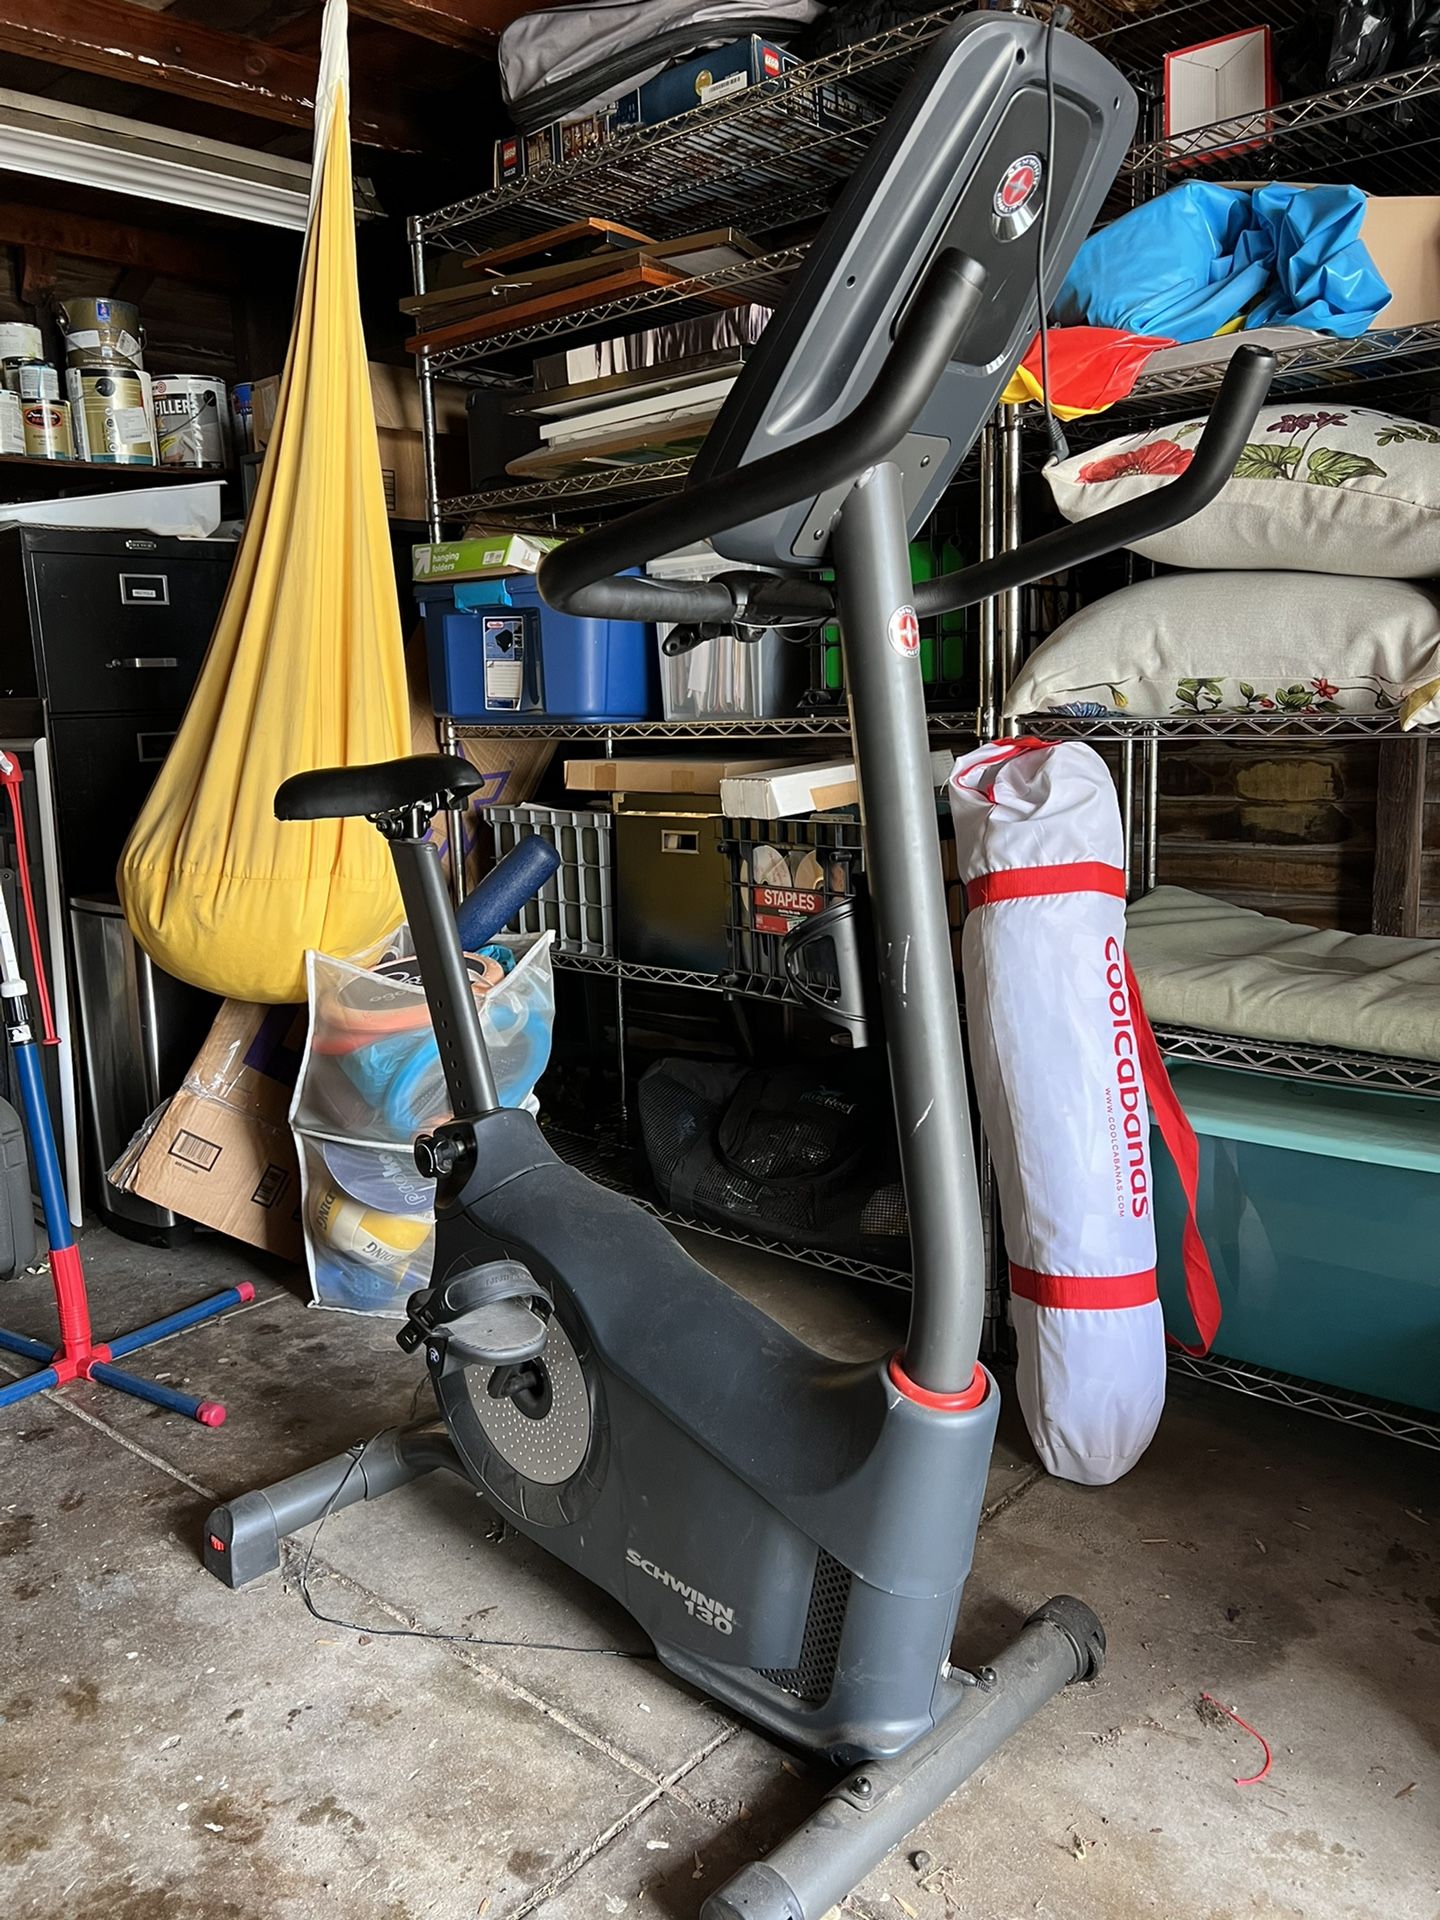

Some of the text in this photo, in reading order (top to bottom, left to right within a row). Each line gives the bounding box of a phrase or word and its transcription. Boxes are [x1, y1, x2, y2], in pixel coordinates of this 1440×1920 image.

[154, 399, 191, 415] FILLER
[432, 563, 455, 573] folders
[433, 552, 460, 565] hanging
[764, 889, 815, 911] STAPLES
[1105, 1087, 1125, 1217] WWW.COOLCABANAS.COM
[625, 1548, 734, 1622] SCHWINN
[684, 1600, 732, 1635] 130
